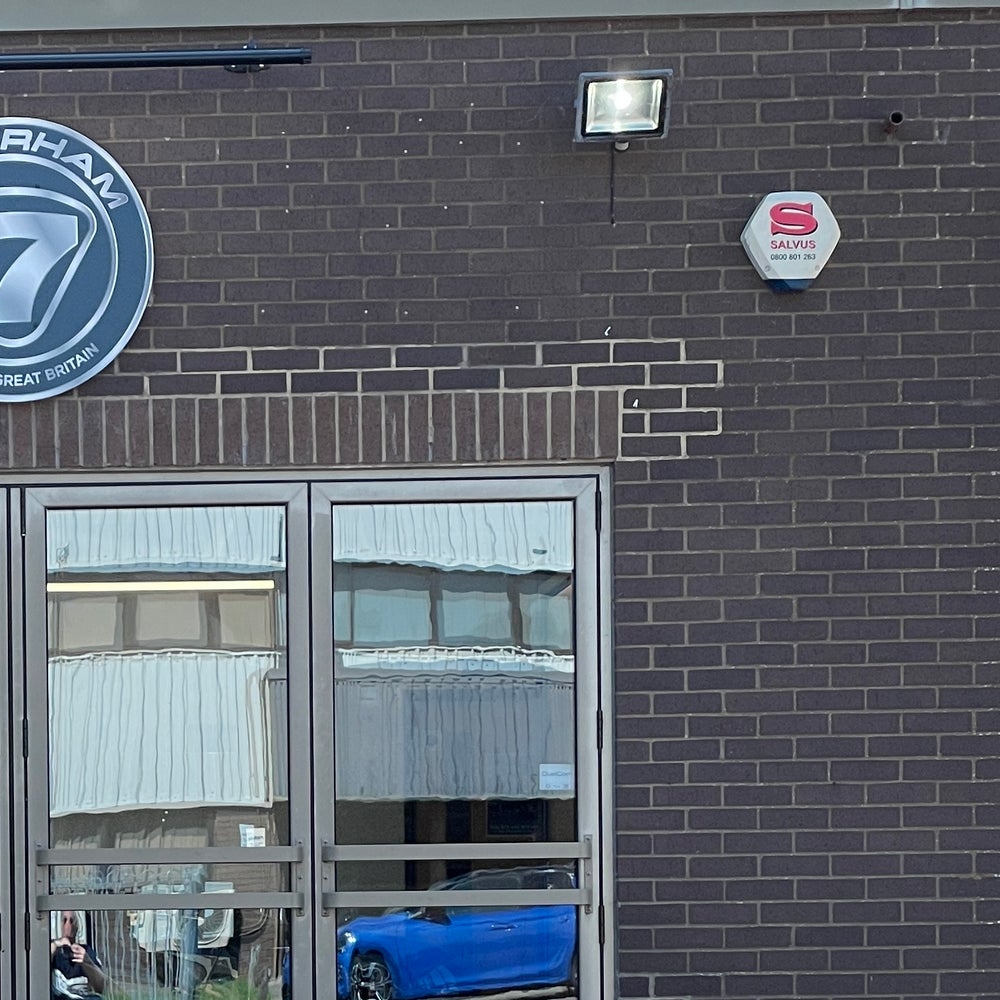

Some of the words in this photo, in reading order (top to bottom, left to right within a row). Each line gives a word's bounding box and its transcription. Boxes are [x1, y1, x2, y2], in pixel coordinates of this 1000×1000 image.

[770, 240, 816, 250] SALVUS
[770, 253, 788, 261] 0800
[45, 342, 100, 382] BRITAIN
